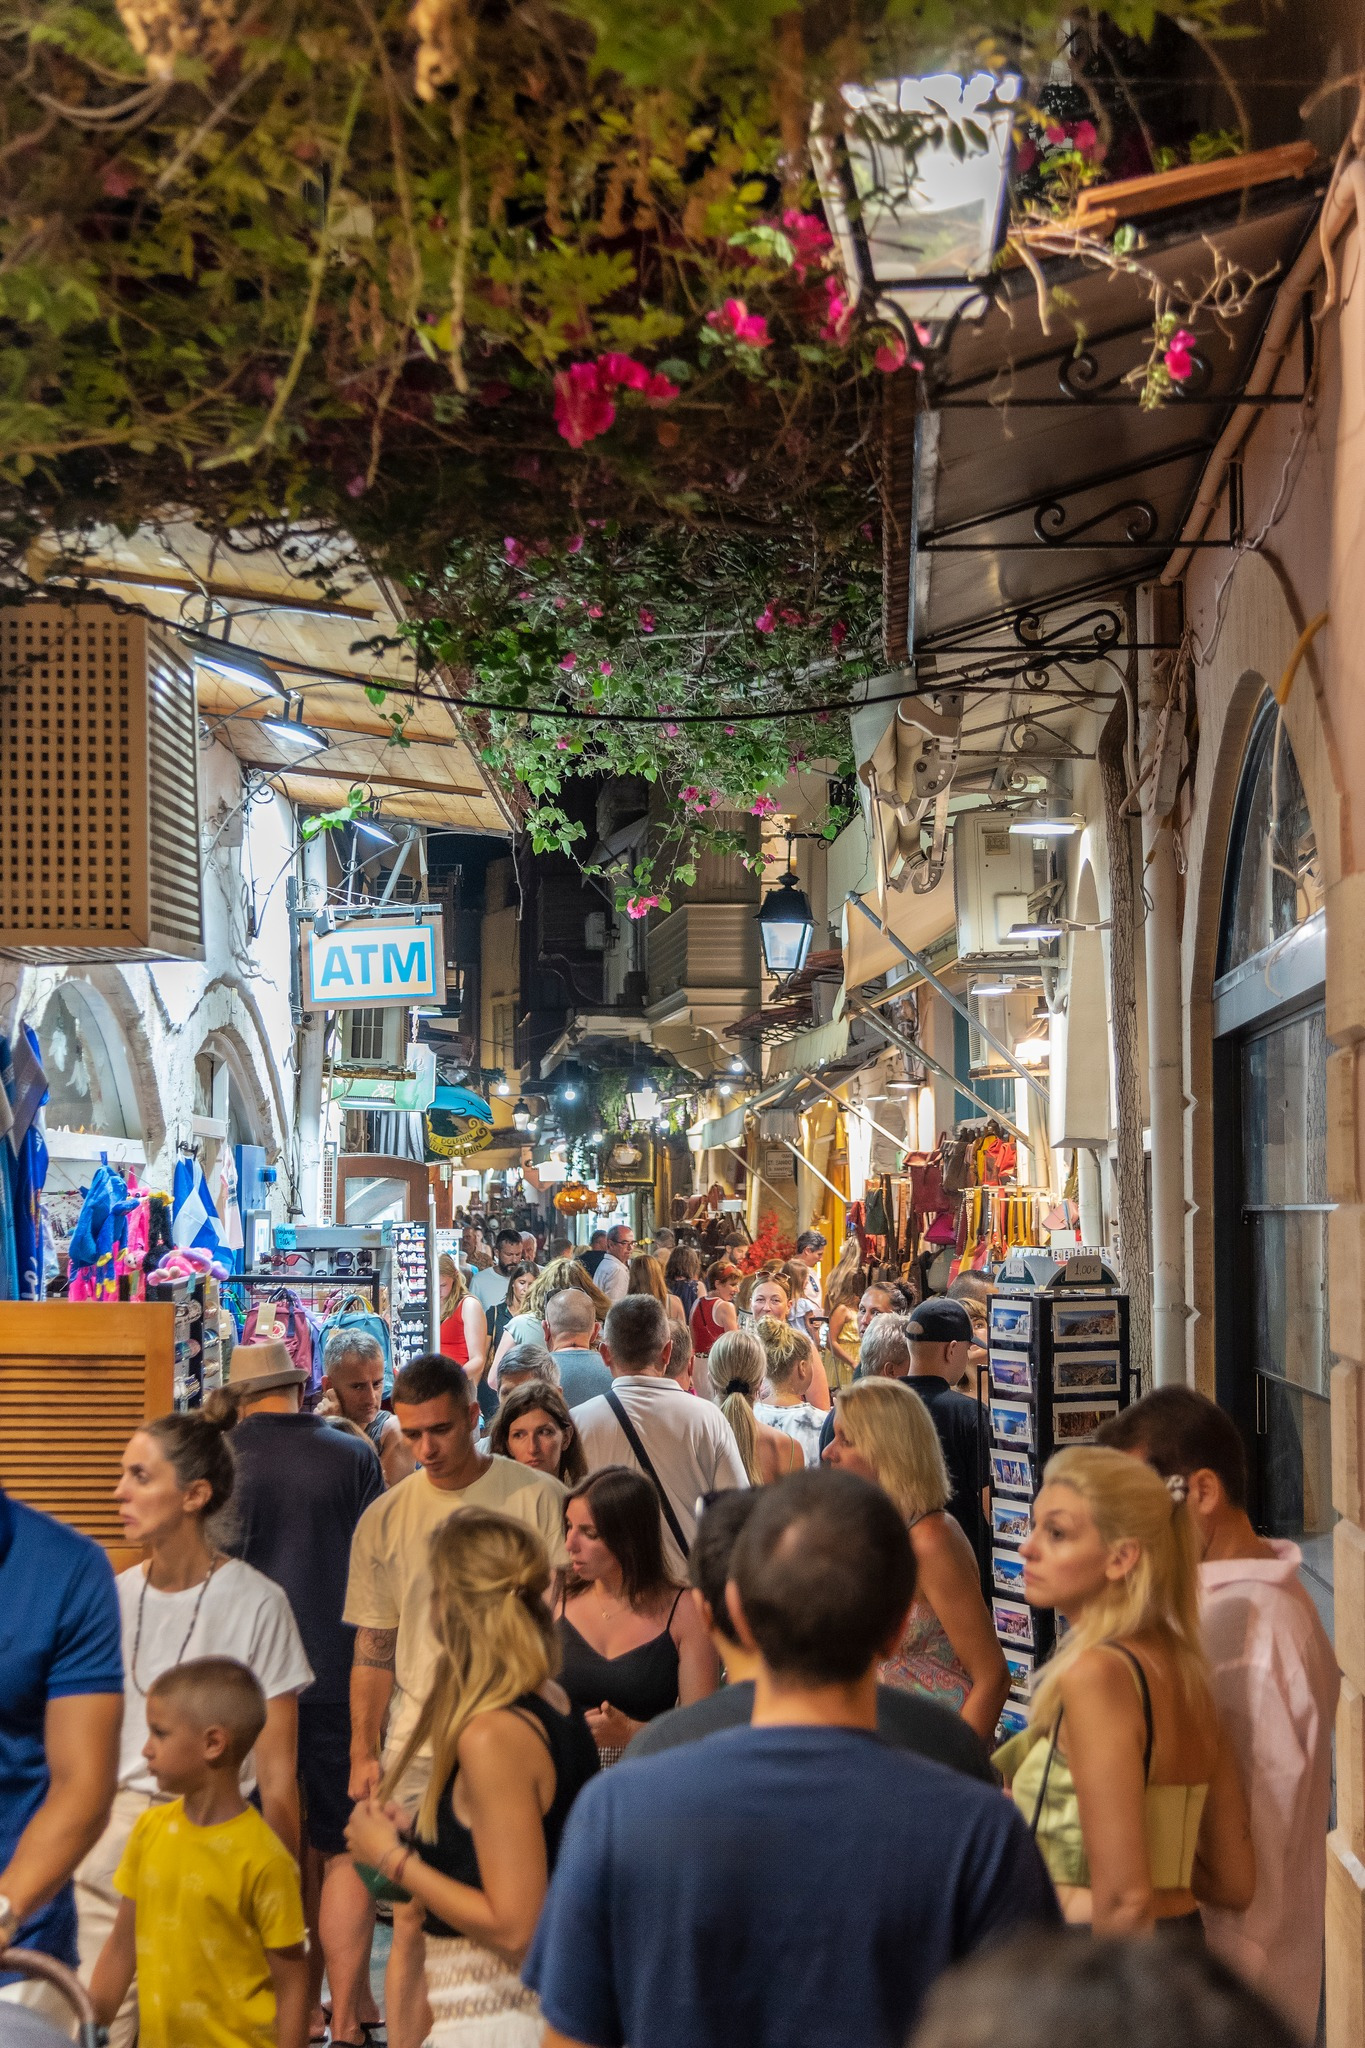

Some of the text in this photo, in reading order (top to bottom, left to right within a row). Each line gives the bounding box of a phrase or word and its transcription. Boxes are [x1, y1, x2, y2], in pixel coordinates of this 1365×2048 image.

[320, 941, 427, 987] ATM
[441, 1133, 473, 1144] DOLPHIN
[447, 1143, 483, 1156] DOLPHIN
